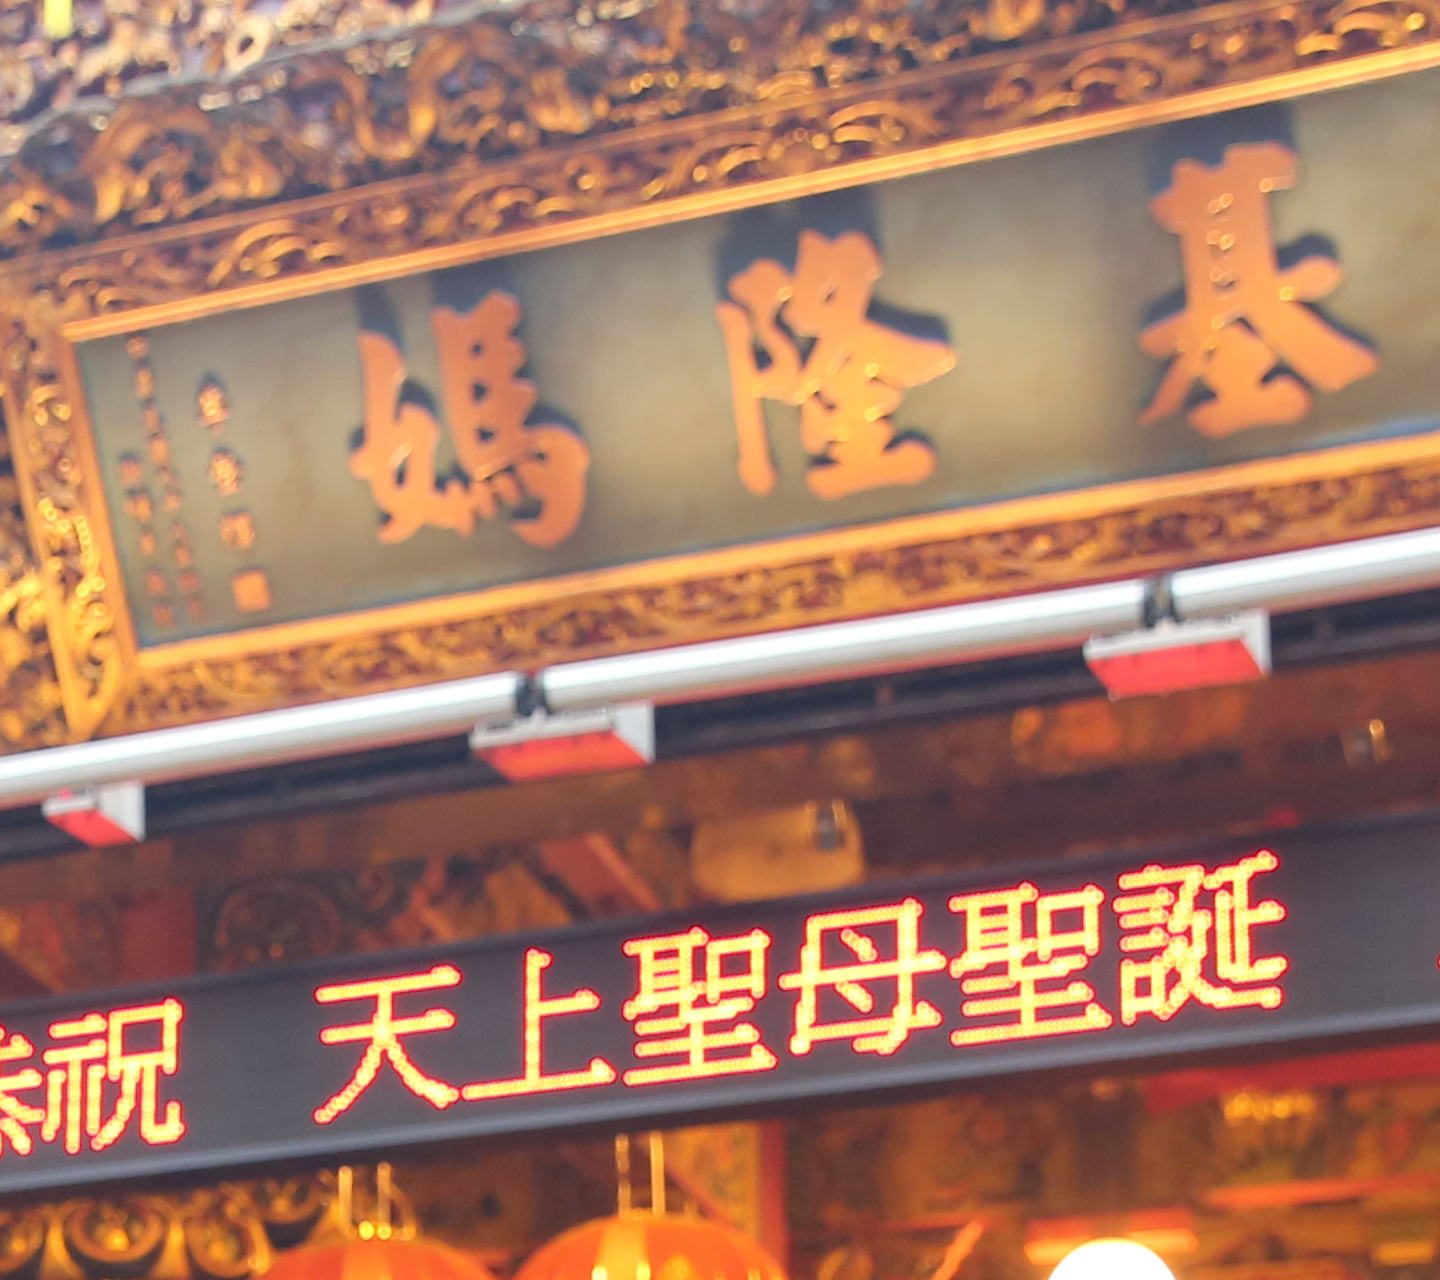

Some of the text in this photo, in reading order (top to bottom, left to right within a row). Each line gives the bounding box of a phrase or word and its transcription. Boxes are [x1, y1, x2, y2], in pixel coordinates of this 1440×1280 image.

[349, 140, 1382, 549] 基隆媽
[312, 849, 1288, 1124] 天上聖母聖誕
